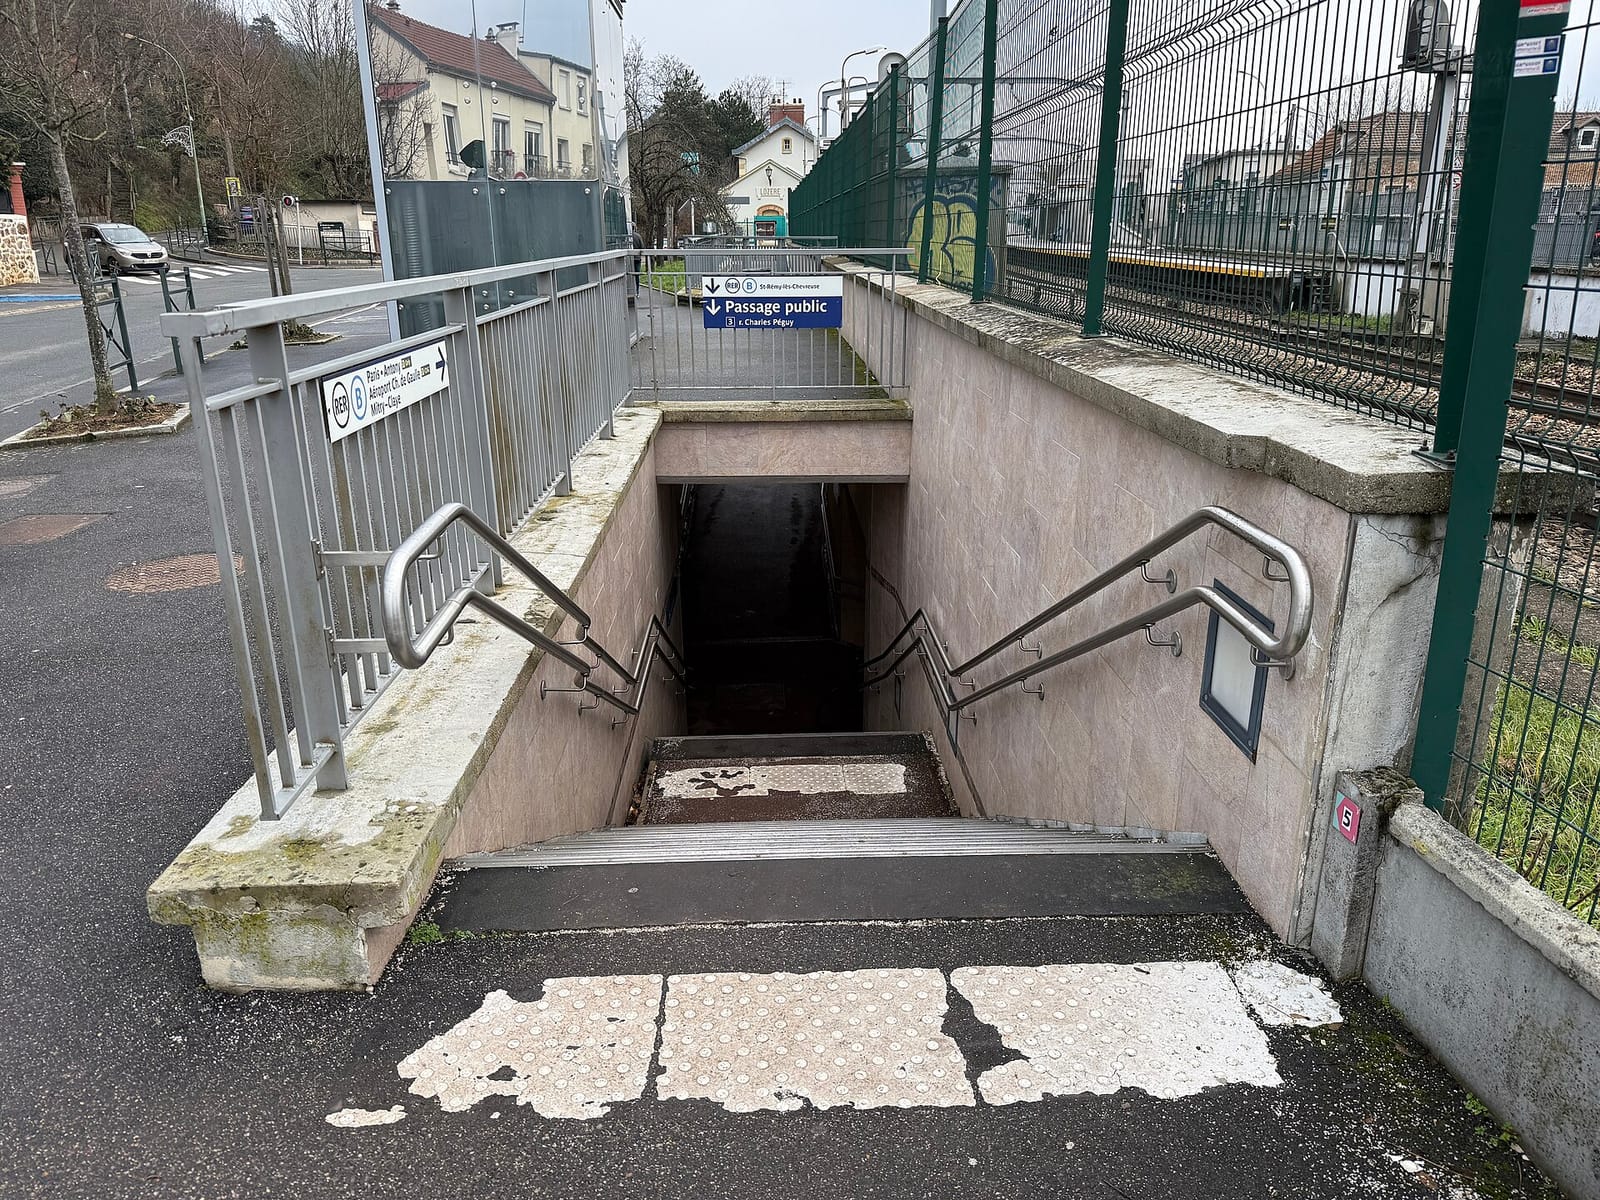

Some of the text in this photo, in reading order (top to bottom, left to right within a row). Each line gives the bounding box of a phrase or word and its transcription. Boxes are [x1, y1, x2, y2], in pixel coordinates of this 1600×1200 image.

[726, 282, 739, 290] RER
[746, 281, 753, 290] B
[725, 299, 828, 316] Passage public
[727, 318, 734, 326] 3
[744, 318, 772, 326] Charles
[772, 317, 794, 328] Péguy
[366, 368, 380, 383] Paris
[383, 361, 401, 377] Antony
[369, 382, 391, 400] Aéroport
[392, 377, 400, 390] Ch.
[400, 375, 407, 386] de
[407, 370, 421, 384] Gaulle
[334, 387, 363, 416] RER B
[370, 394, 401, 416] Mitry-Claye
[1342, 809, 1351, 827] 5
